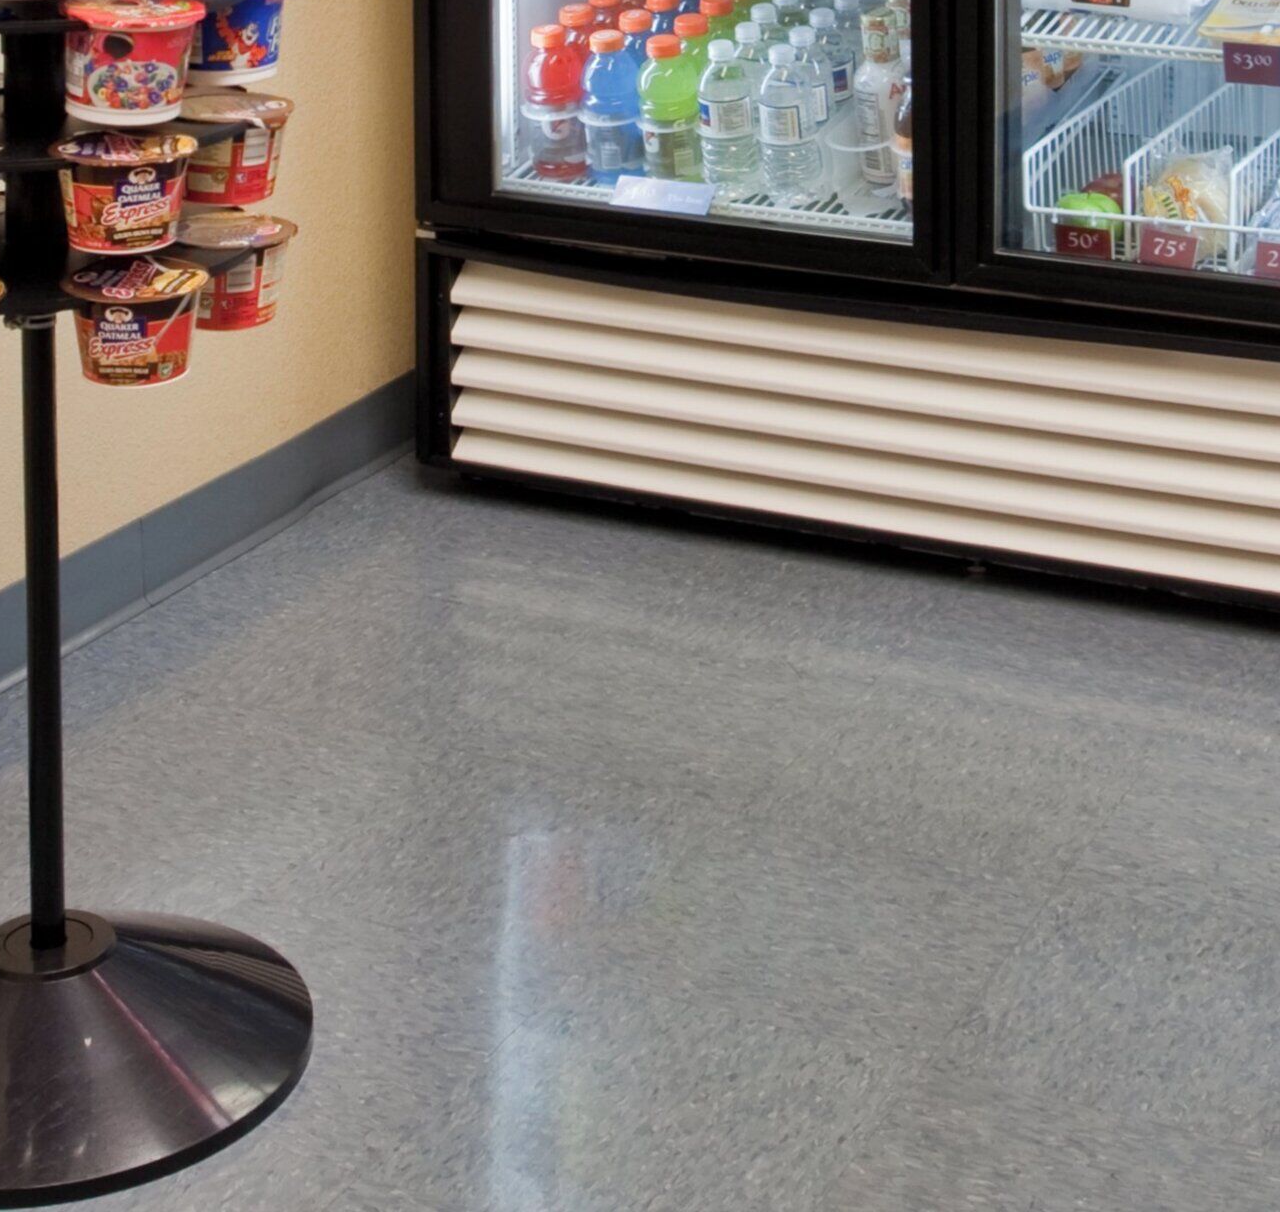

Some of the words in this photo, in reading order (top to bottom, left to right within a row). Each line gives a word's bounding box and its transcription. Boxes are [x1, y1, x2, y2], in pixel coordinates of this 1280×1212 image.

[101, 198, 170, 226] Express
[1067, 230, 1100, 250] 50¢
[1153, 237, 1187, 258] 75¢
[89, 337, 157, 359] Express
